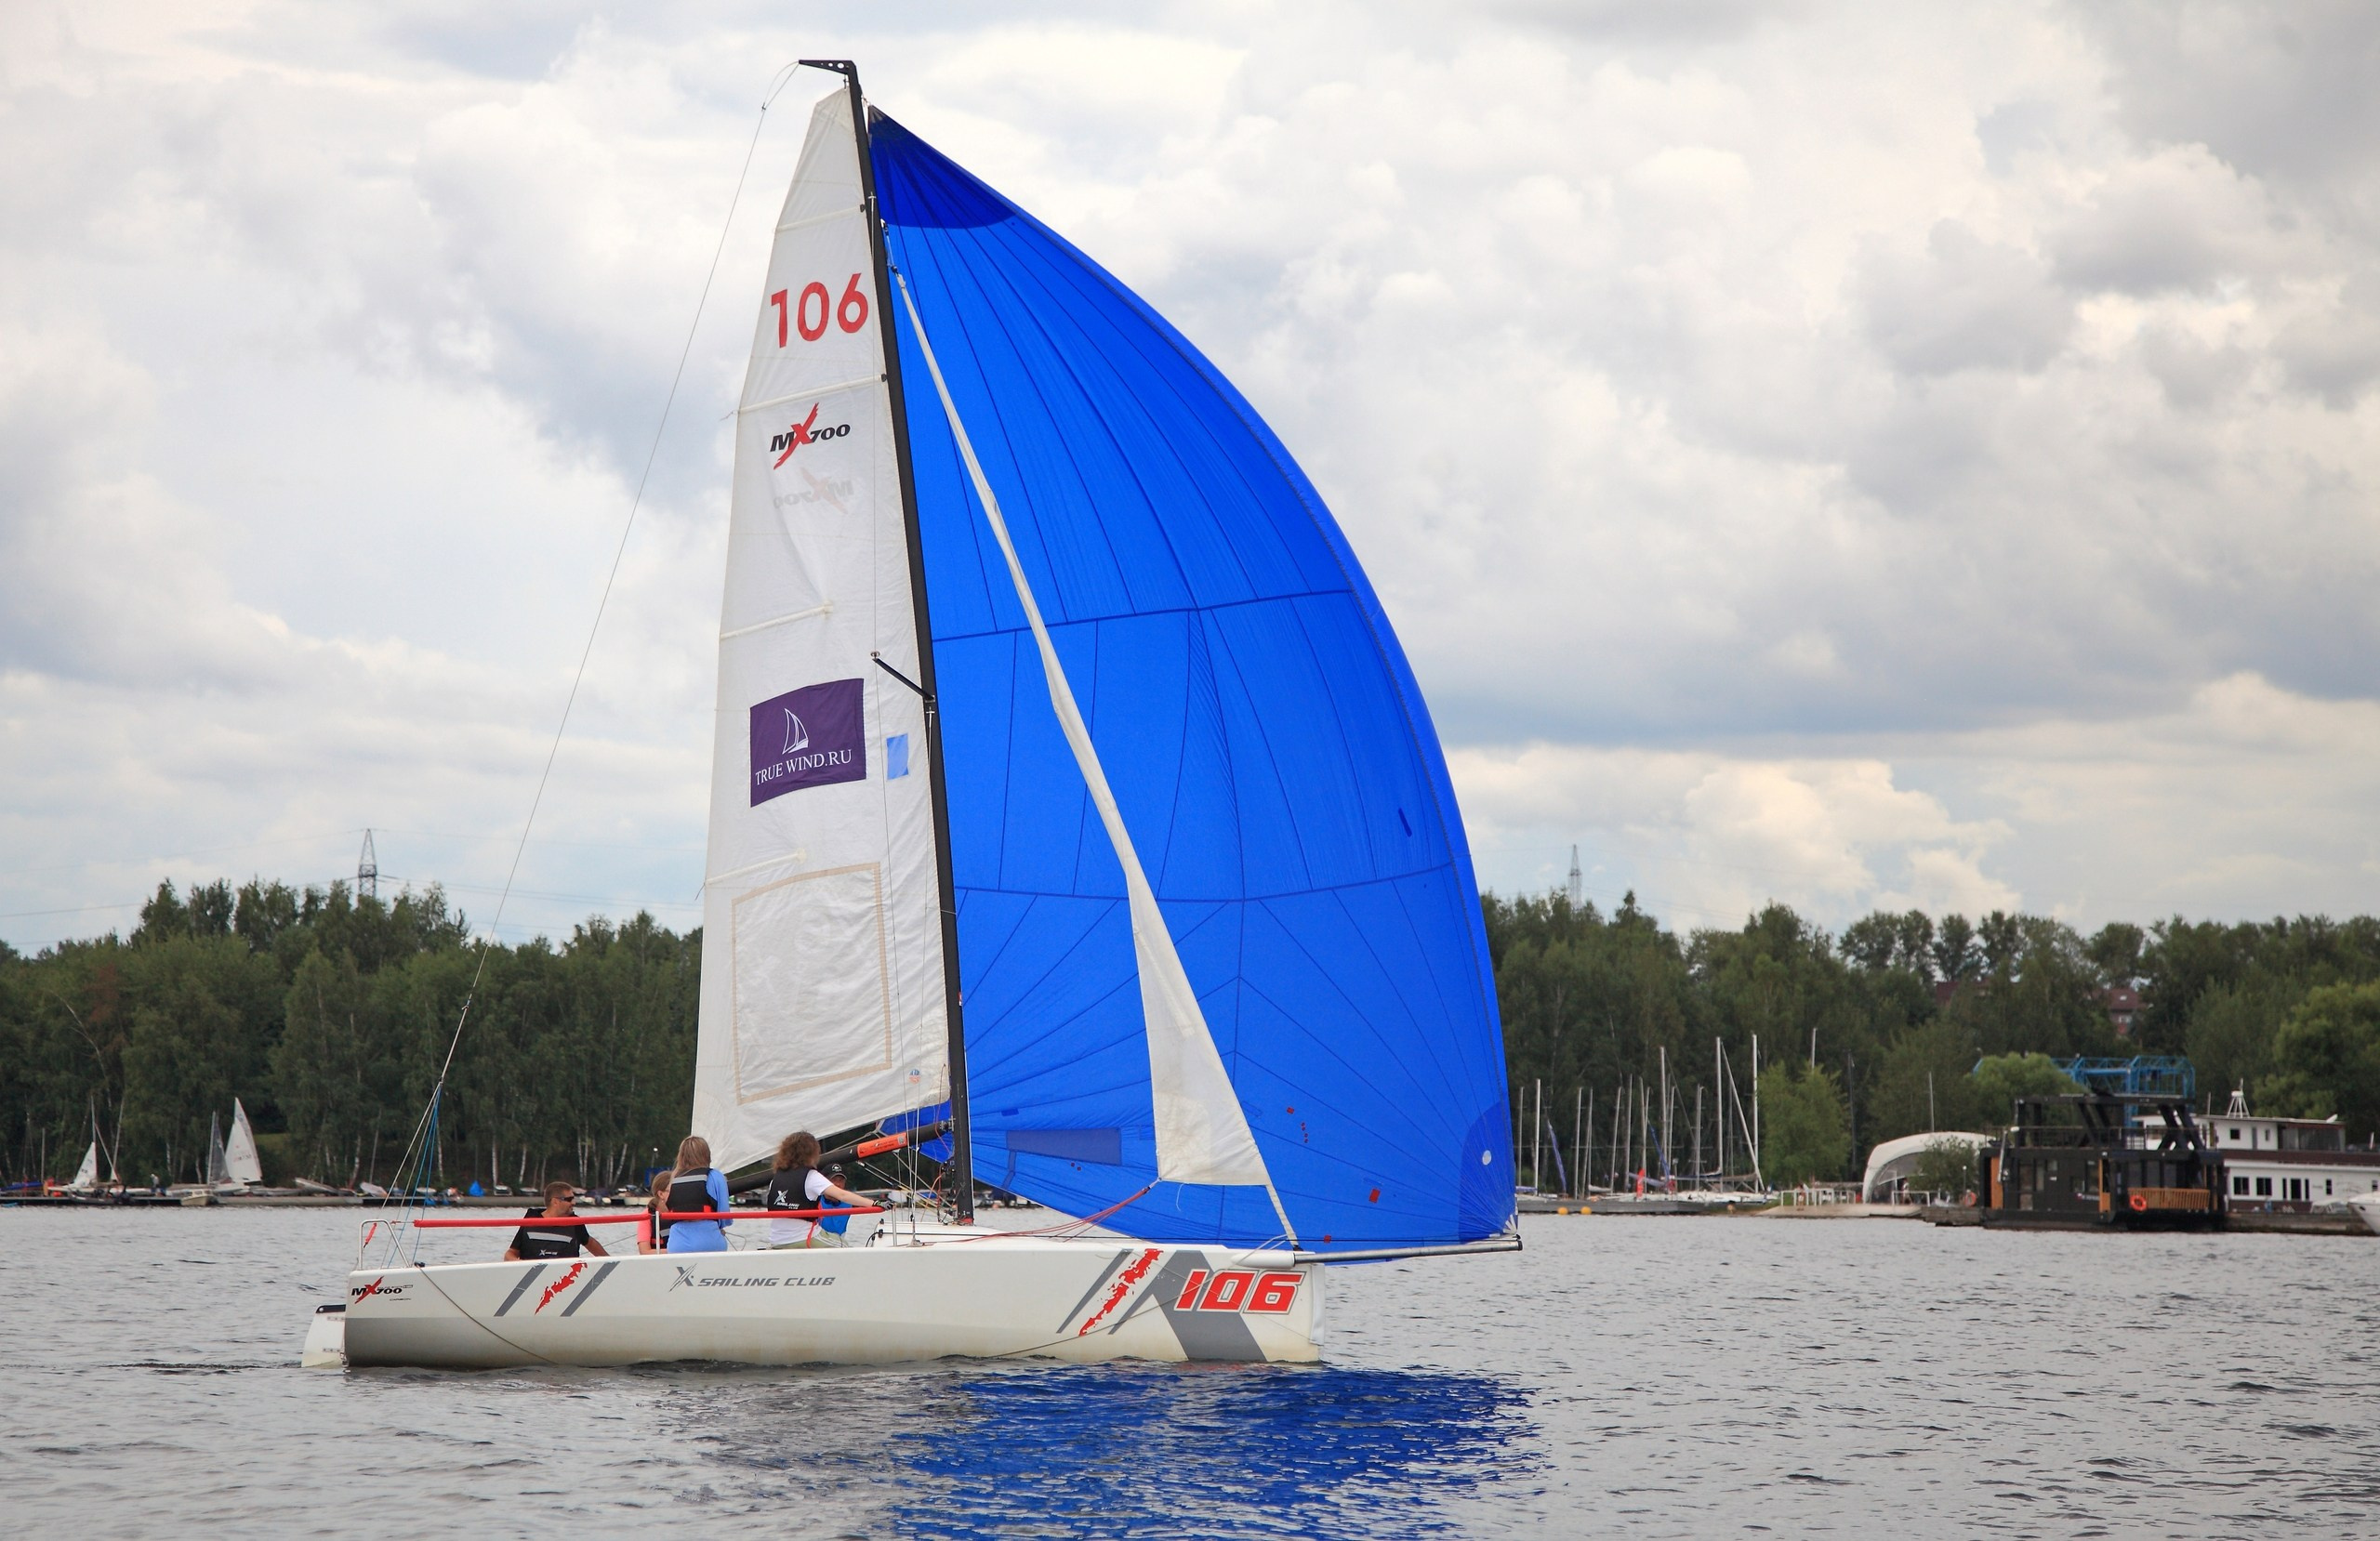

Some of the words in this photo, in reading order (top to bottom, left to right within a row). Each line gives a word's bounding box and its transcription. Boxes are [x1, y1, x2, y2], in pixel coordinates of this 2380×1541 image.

[771, 272, 868, 349] 106
[770, 402, 851, 469] MX700
[756, 762, 783, 785] TRUE
[786, 749, 852, 773] WIND.RU
[351, 1275, 402, 1304] MX700
[698, 1278, 780, 1286] SAILING
[784, 1277, 835, 1286] CLUB
[1174, 1268, 1307, 1315] 106
